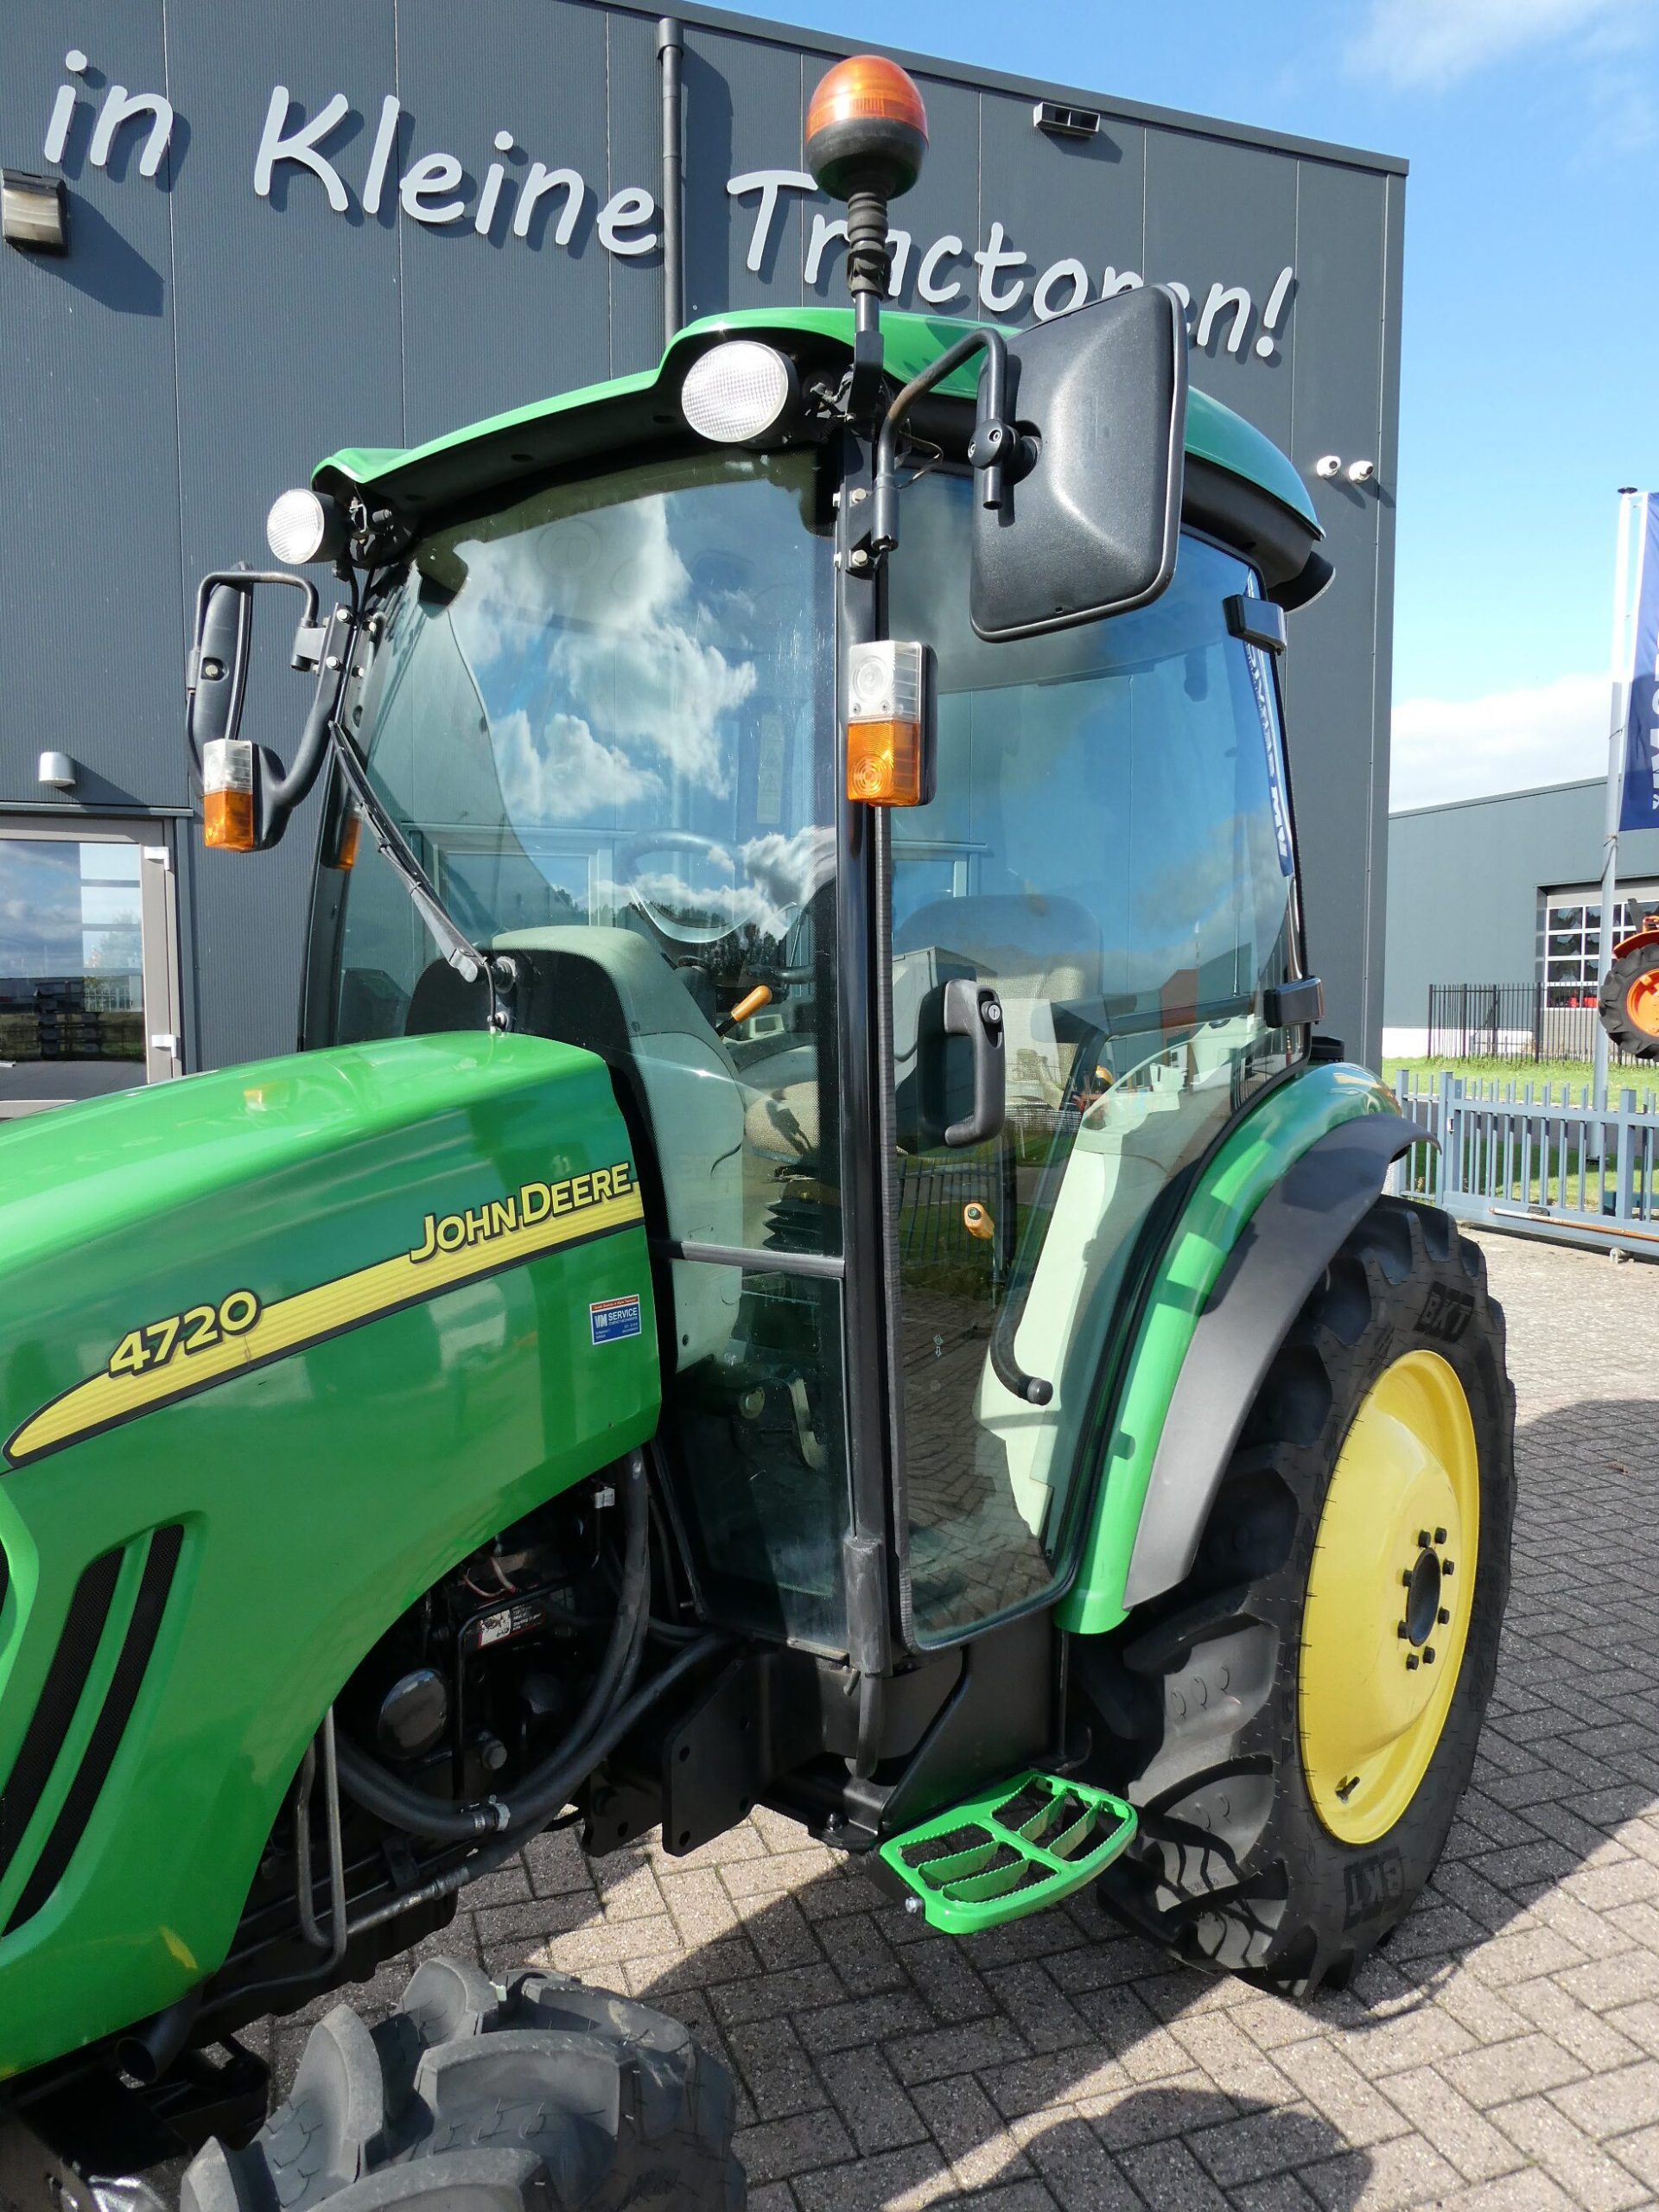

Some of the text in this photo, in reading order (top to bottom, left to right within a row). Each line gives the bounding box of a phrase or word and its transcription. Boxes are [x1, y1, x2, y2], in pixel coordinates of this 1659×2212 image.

[43, 49, 174, 177] in
[253, 85, 658, 256] Kleine
[410, 1161, 632, 1262] JOHN DEERE
[108, 1289, 259, 1376] 4720
[608, 1307, 638, 1321] SERVICE
[1419, 1287, 1474, 1338] BKT
